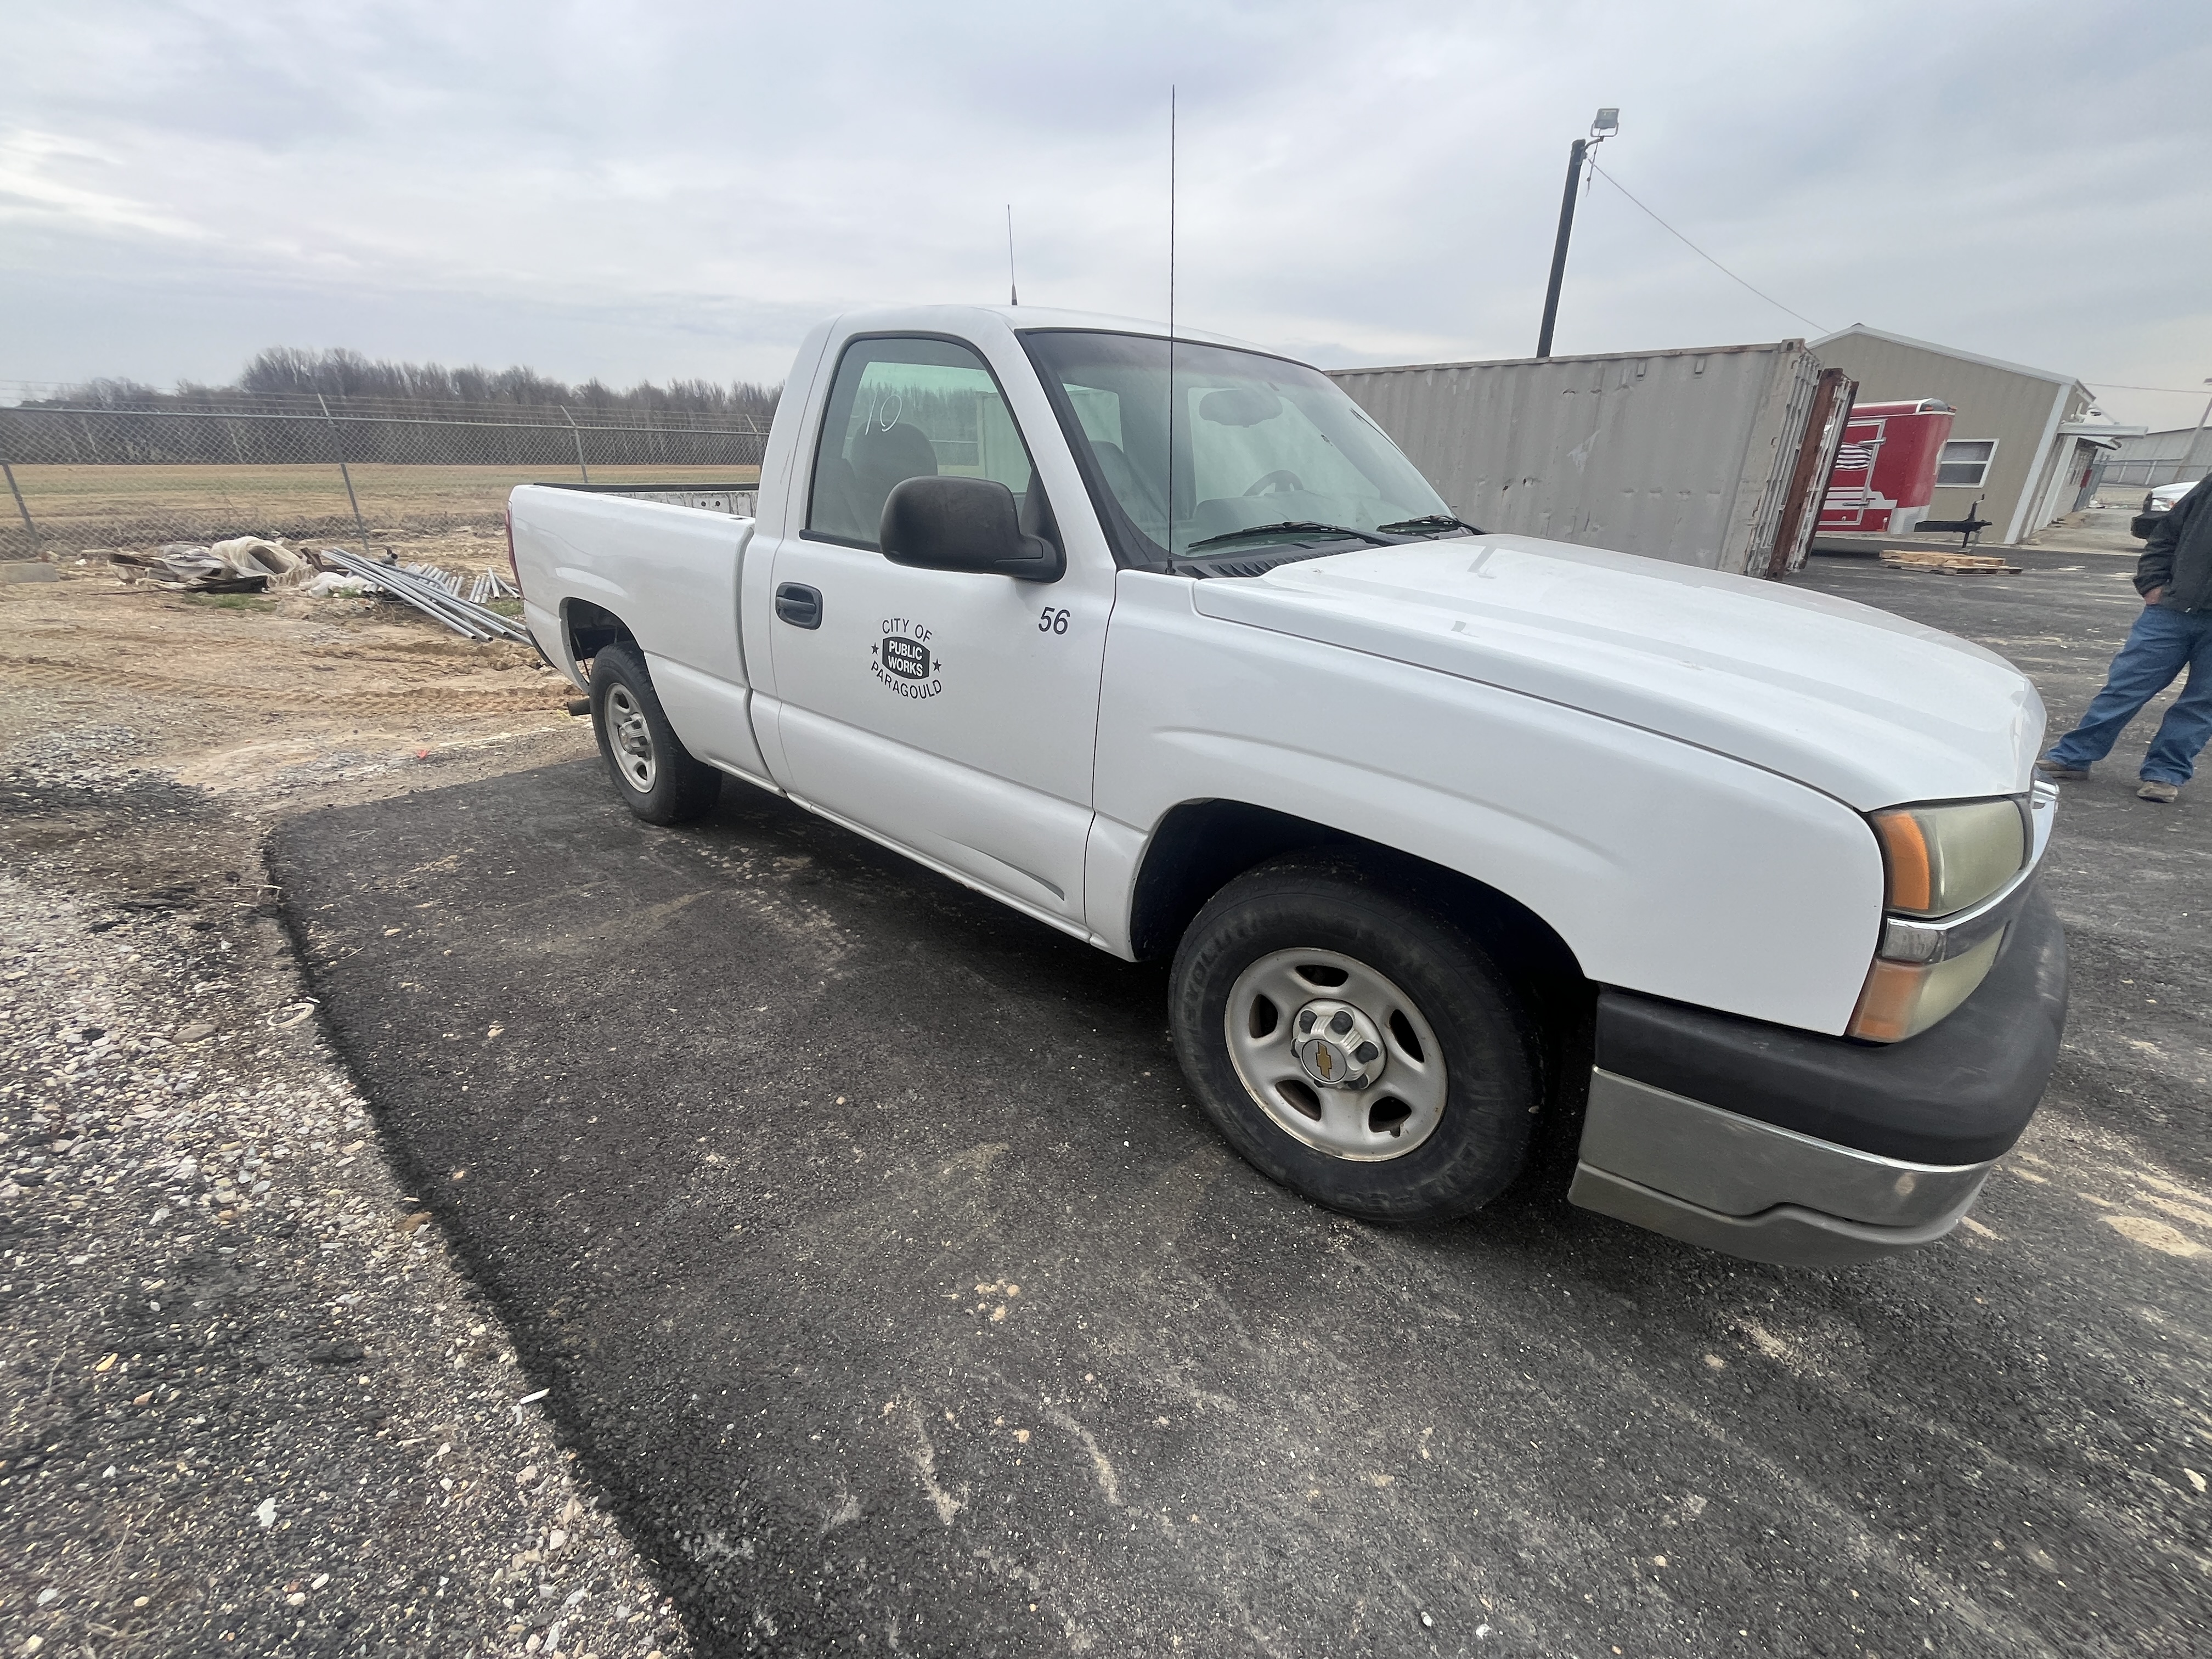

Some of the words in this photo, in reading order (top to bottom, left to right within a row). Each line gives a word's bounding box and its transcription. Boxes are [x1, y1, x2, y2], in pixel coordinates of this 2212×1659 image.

[882, 618, 910, 634] CITY
[915, 624, 933, 642] OF
[1038, 606, 1071, 635] 56
[889, 640, 923, 661] PUBLIC
[888, 655, 923, 677] WORKS
[871, 660, 942, 699] PARAGOULD
